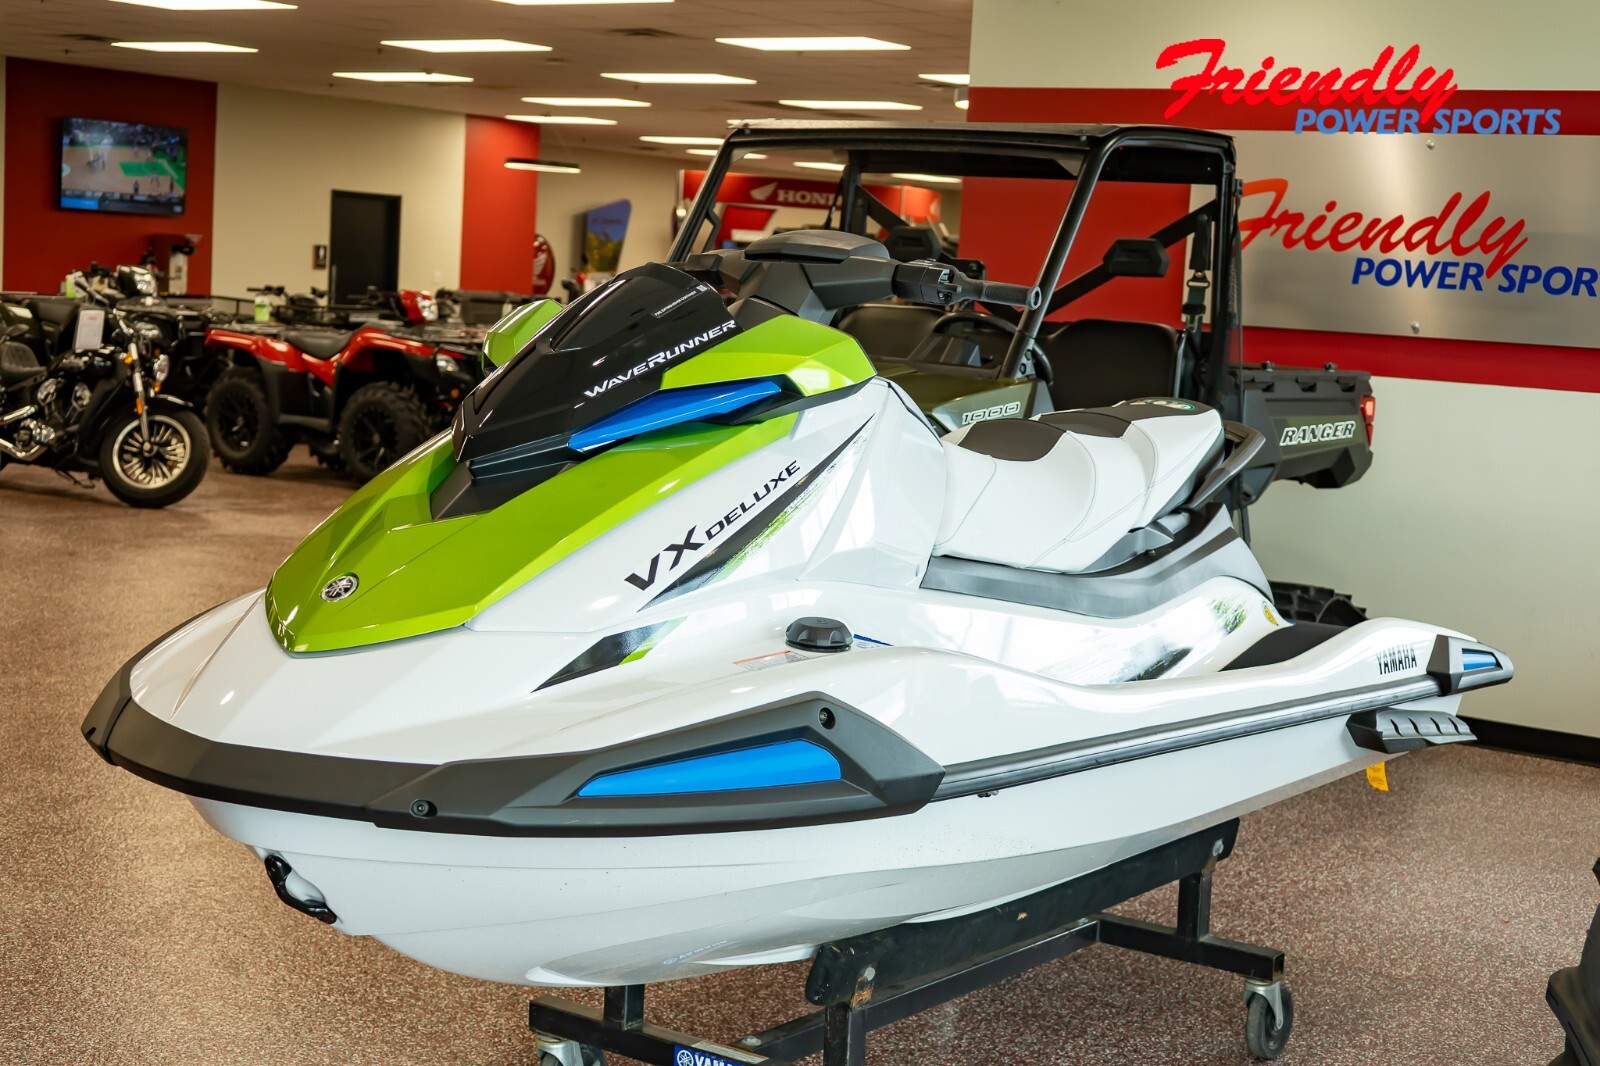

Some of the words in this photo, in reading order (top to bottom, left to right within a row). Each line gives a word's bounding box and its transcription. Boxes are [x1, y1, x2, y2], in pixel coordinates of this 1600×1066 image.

[776, 188, 844, 207] HOND
[1238, 177, 1528, 280] Friendly
[1351, 257, 1484, 291] POWER
[1497, 263, 1600, 297] SPOR
[961, 401, 1021, 425] 1000
[1279, 420, 1356, 446] RANGER
[624, 524, 704, 591] VX
[704, 460, 801, 541] DELUXE
[1376, 645, 1418, 675] YAMAHA
